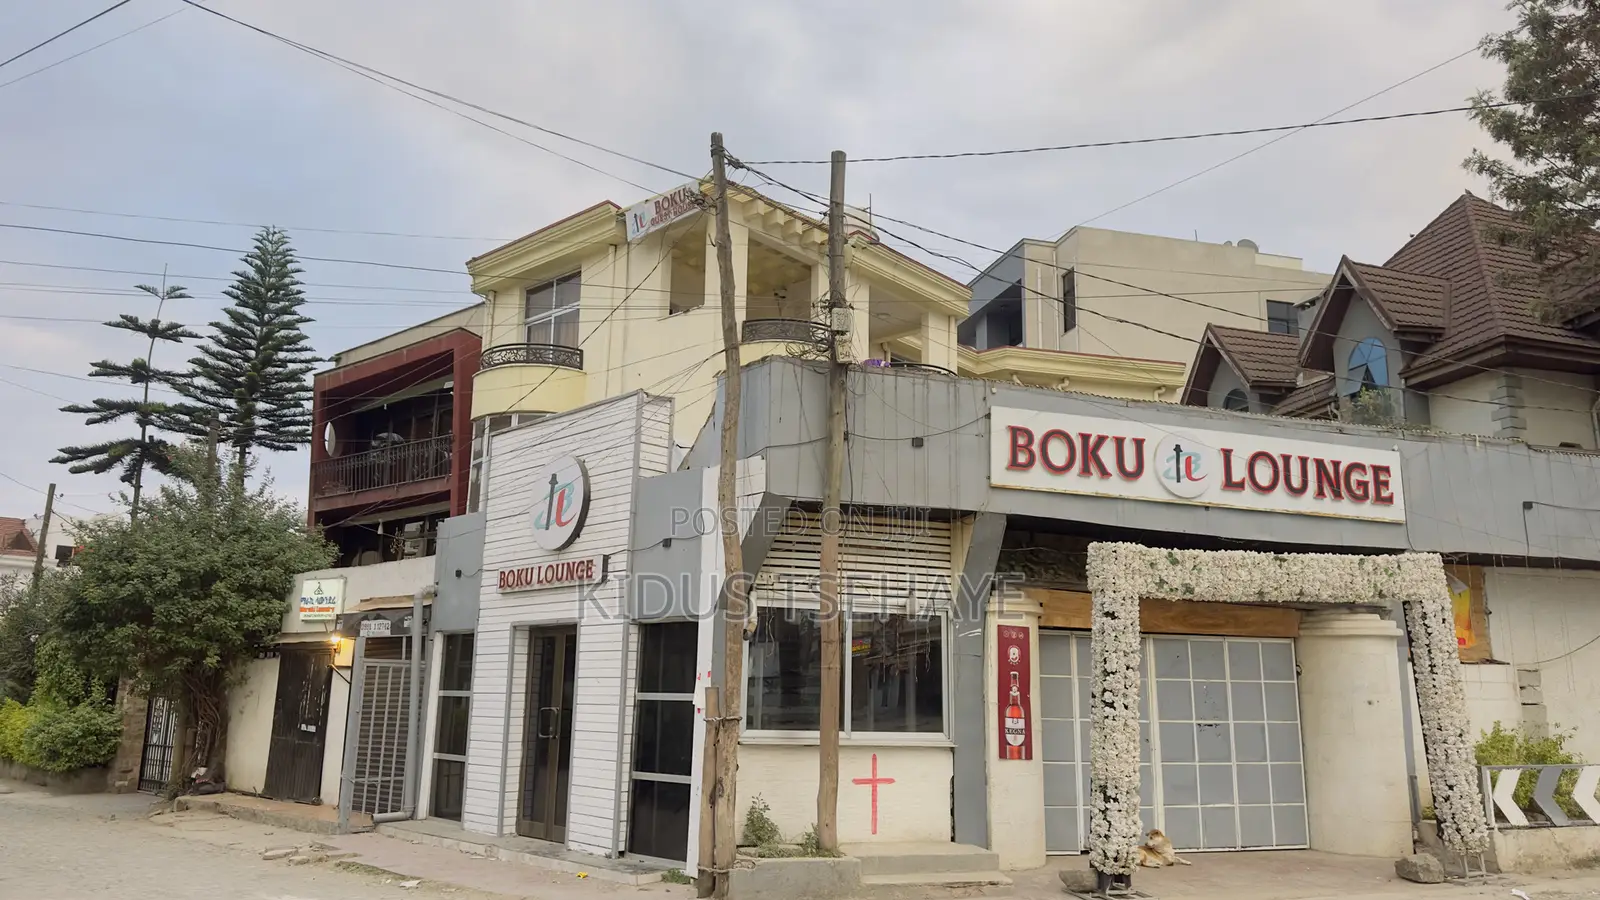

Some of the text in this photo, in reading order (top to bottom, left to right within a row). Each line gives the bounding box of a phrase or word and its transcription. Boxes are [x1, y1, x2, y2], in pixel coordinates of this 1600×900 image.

[654, 187, 687, 215] BOKU
[1007, 425, 1145, 481] BOKU
[1220, 447, 1394, 505] LOUNGE
[499, 559, 594, 589] BOKU LOUNGE
